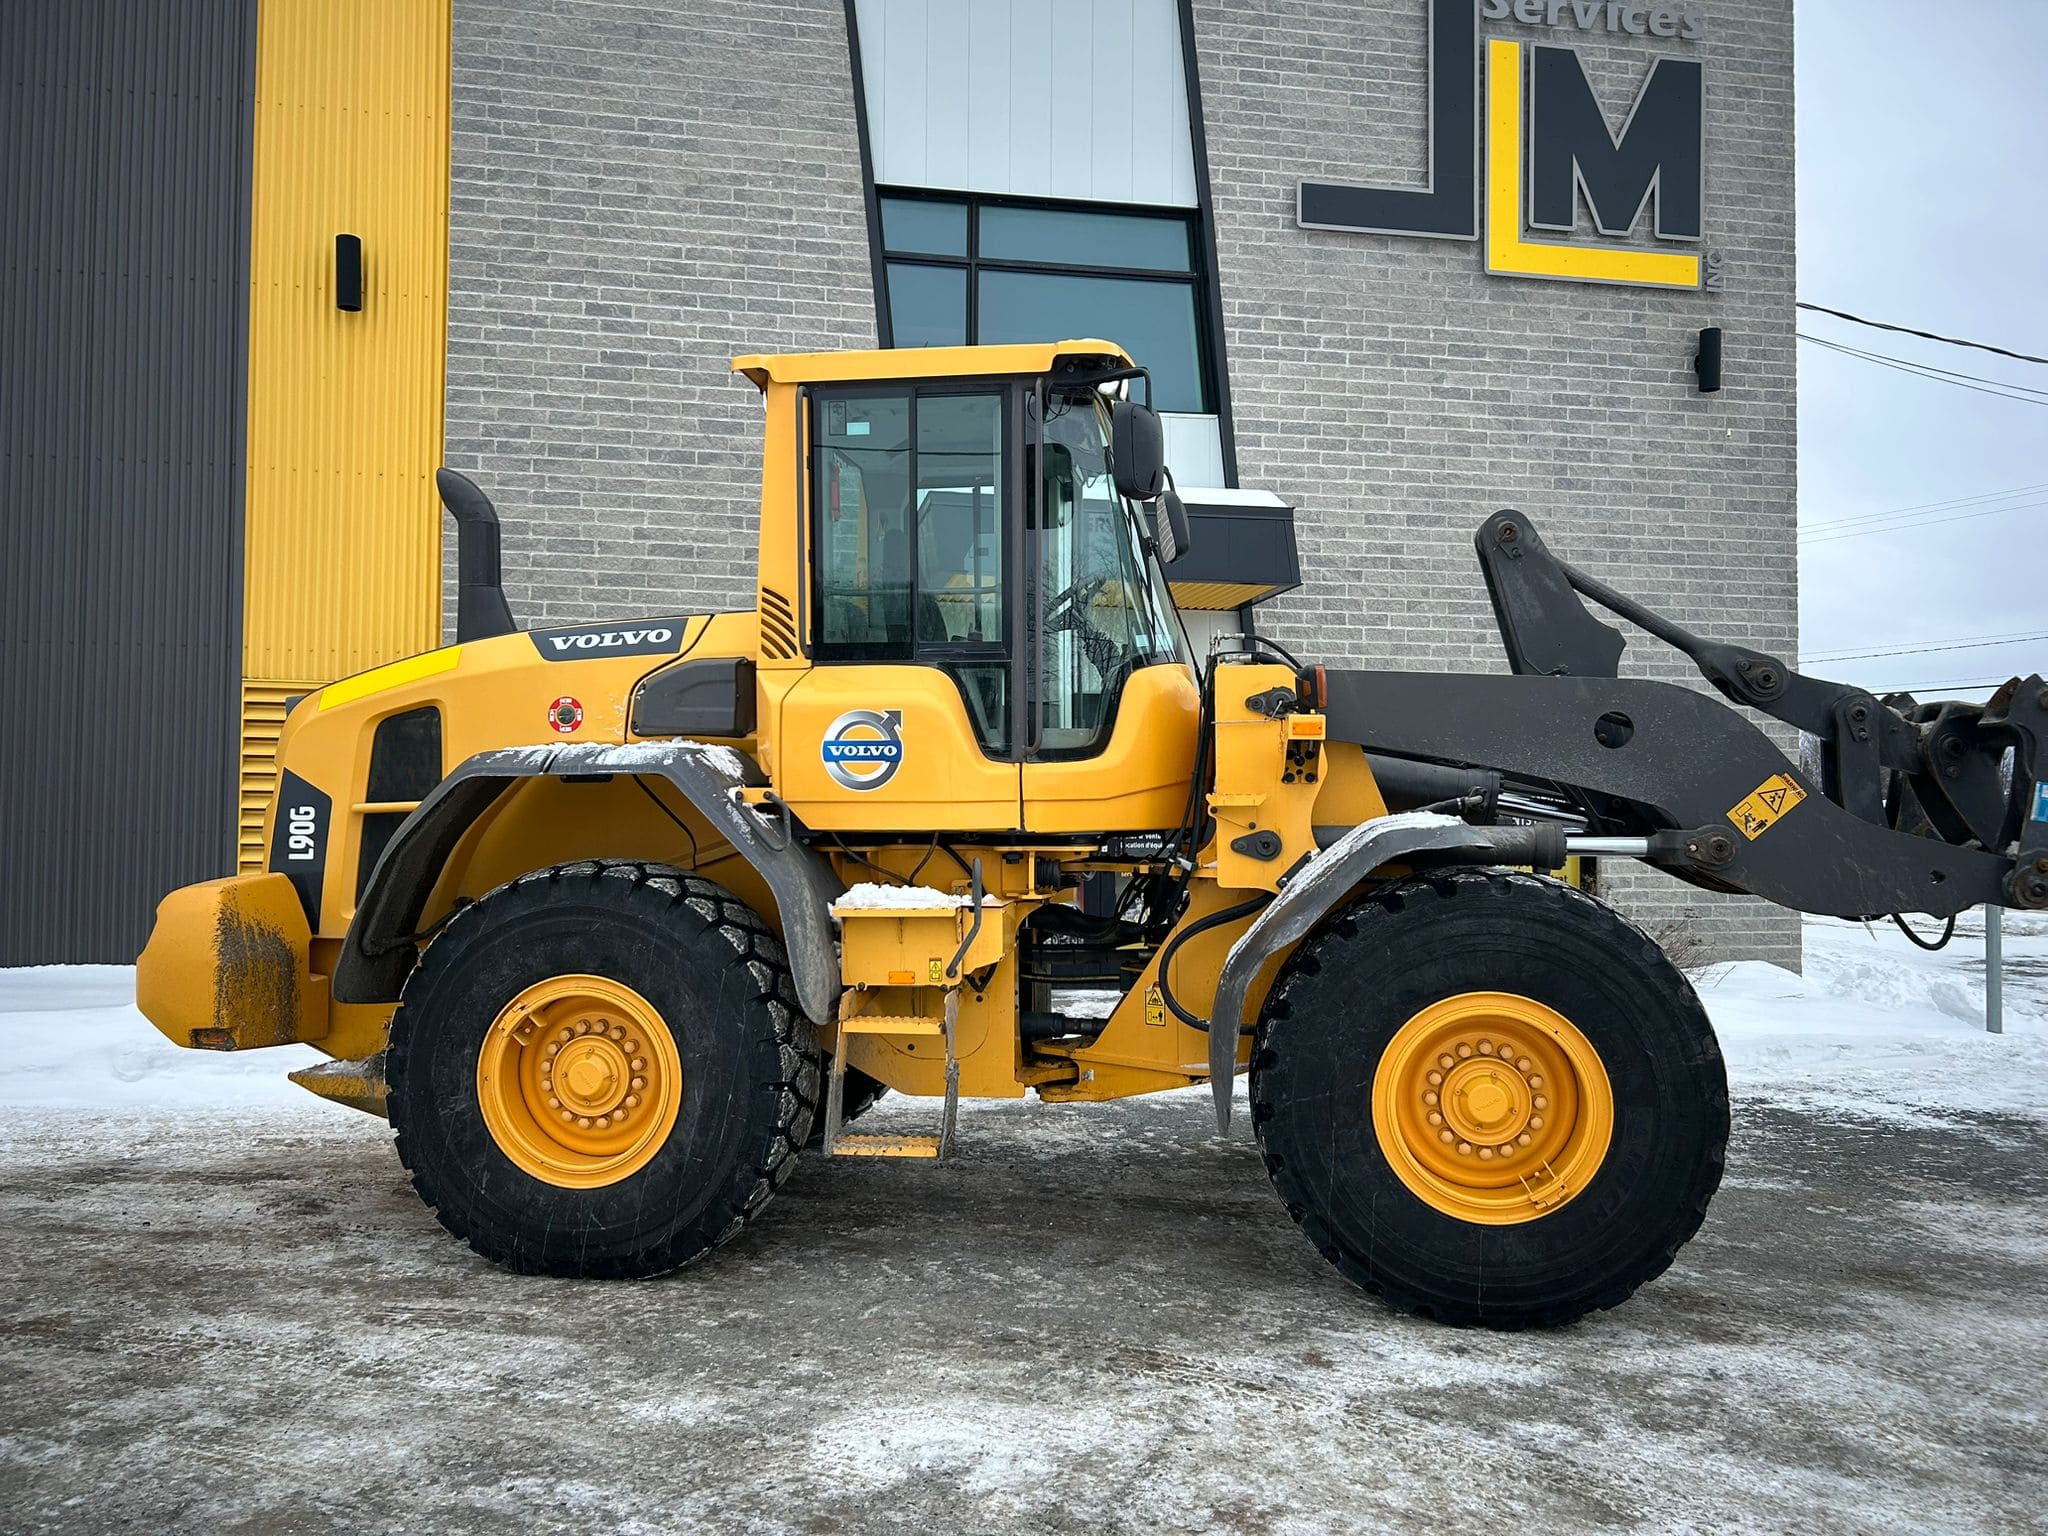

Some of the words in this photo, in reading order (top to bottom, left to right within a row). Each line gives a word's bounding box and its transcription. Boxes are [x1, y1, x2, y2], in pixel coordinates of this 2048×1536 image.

[549, 628, 672, 651] VOLVO
[826, 745, 898, 757] VOLVO
[288, 806, 316, 860] L90G
